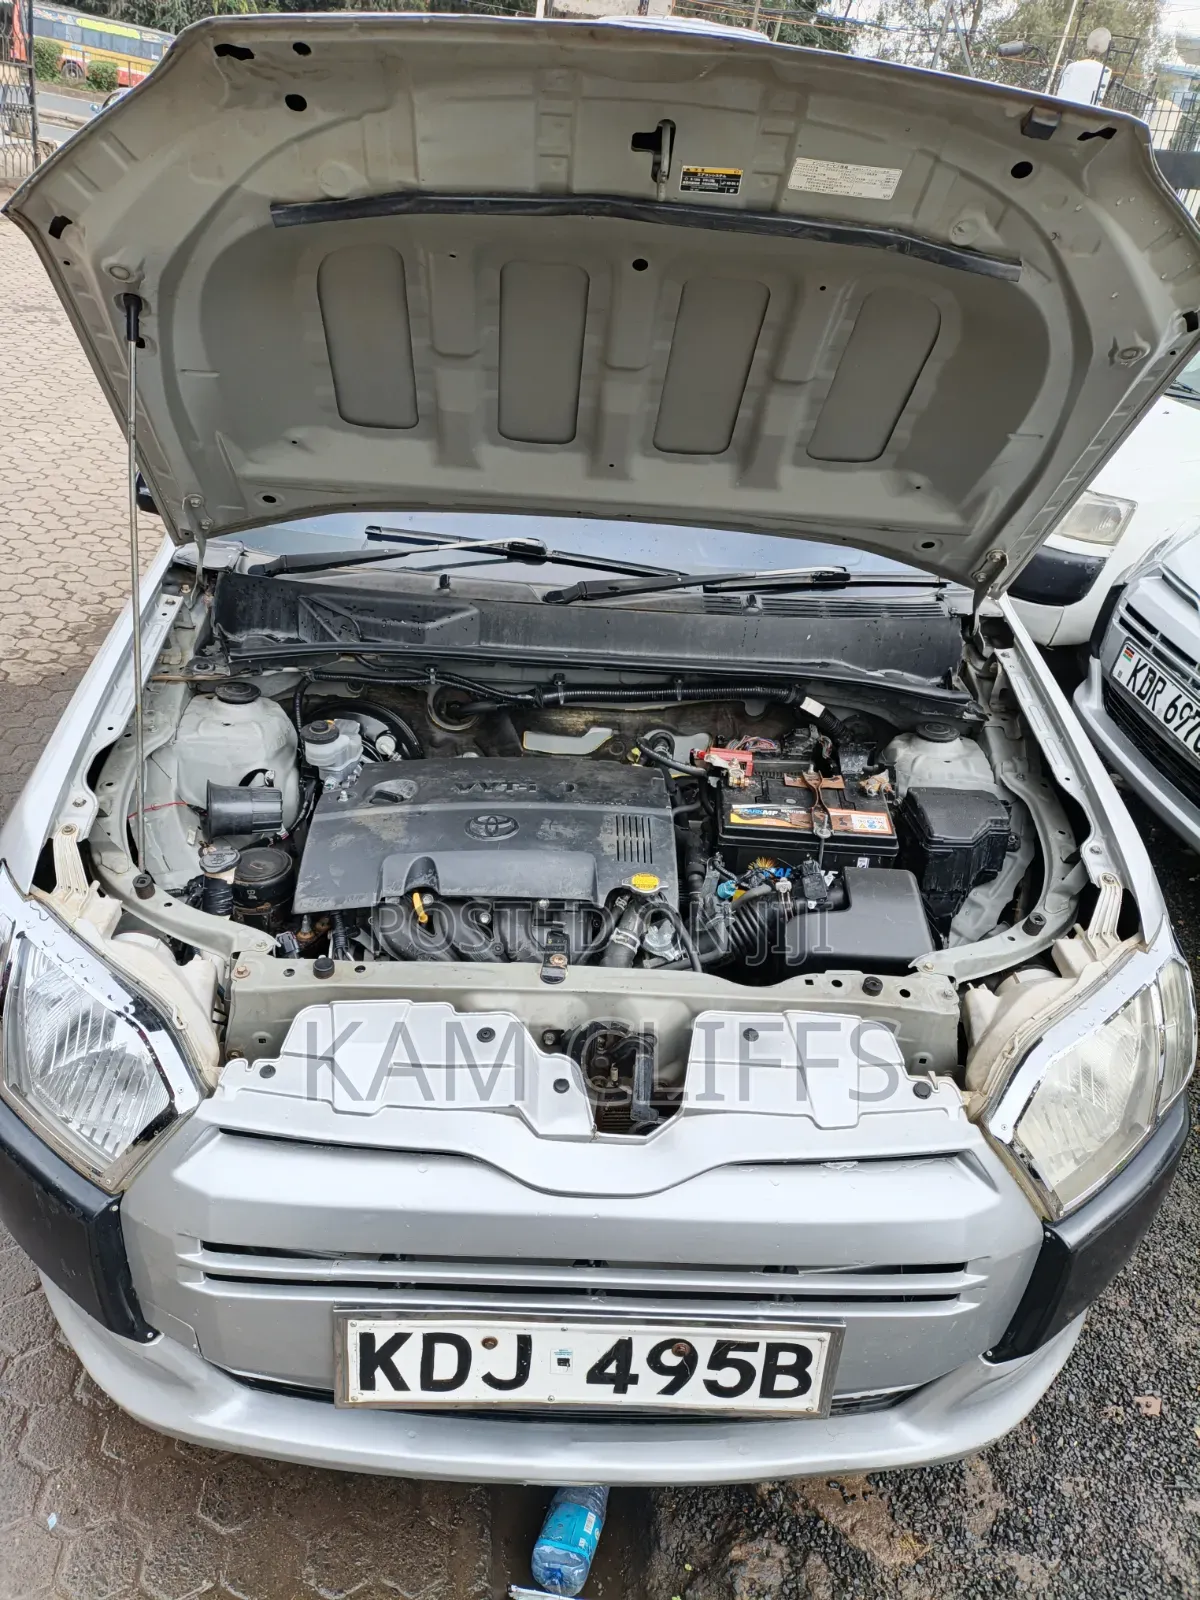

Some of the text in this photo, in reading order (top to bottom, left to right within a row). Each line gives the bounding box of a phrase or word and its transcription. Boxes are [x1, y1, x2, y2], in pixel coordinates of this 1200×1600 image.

[1126, 657, 1167, 712] KDR
[358, 1331, 814, 1399] KDJ 495B
